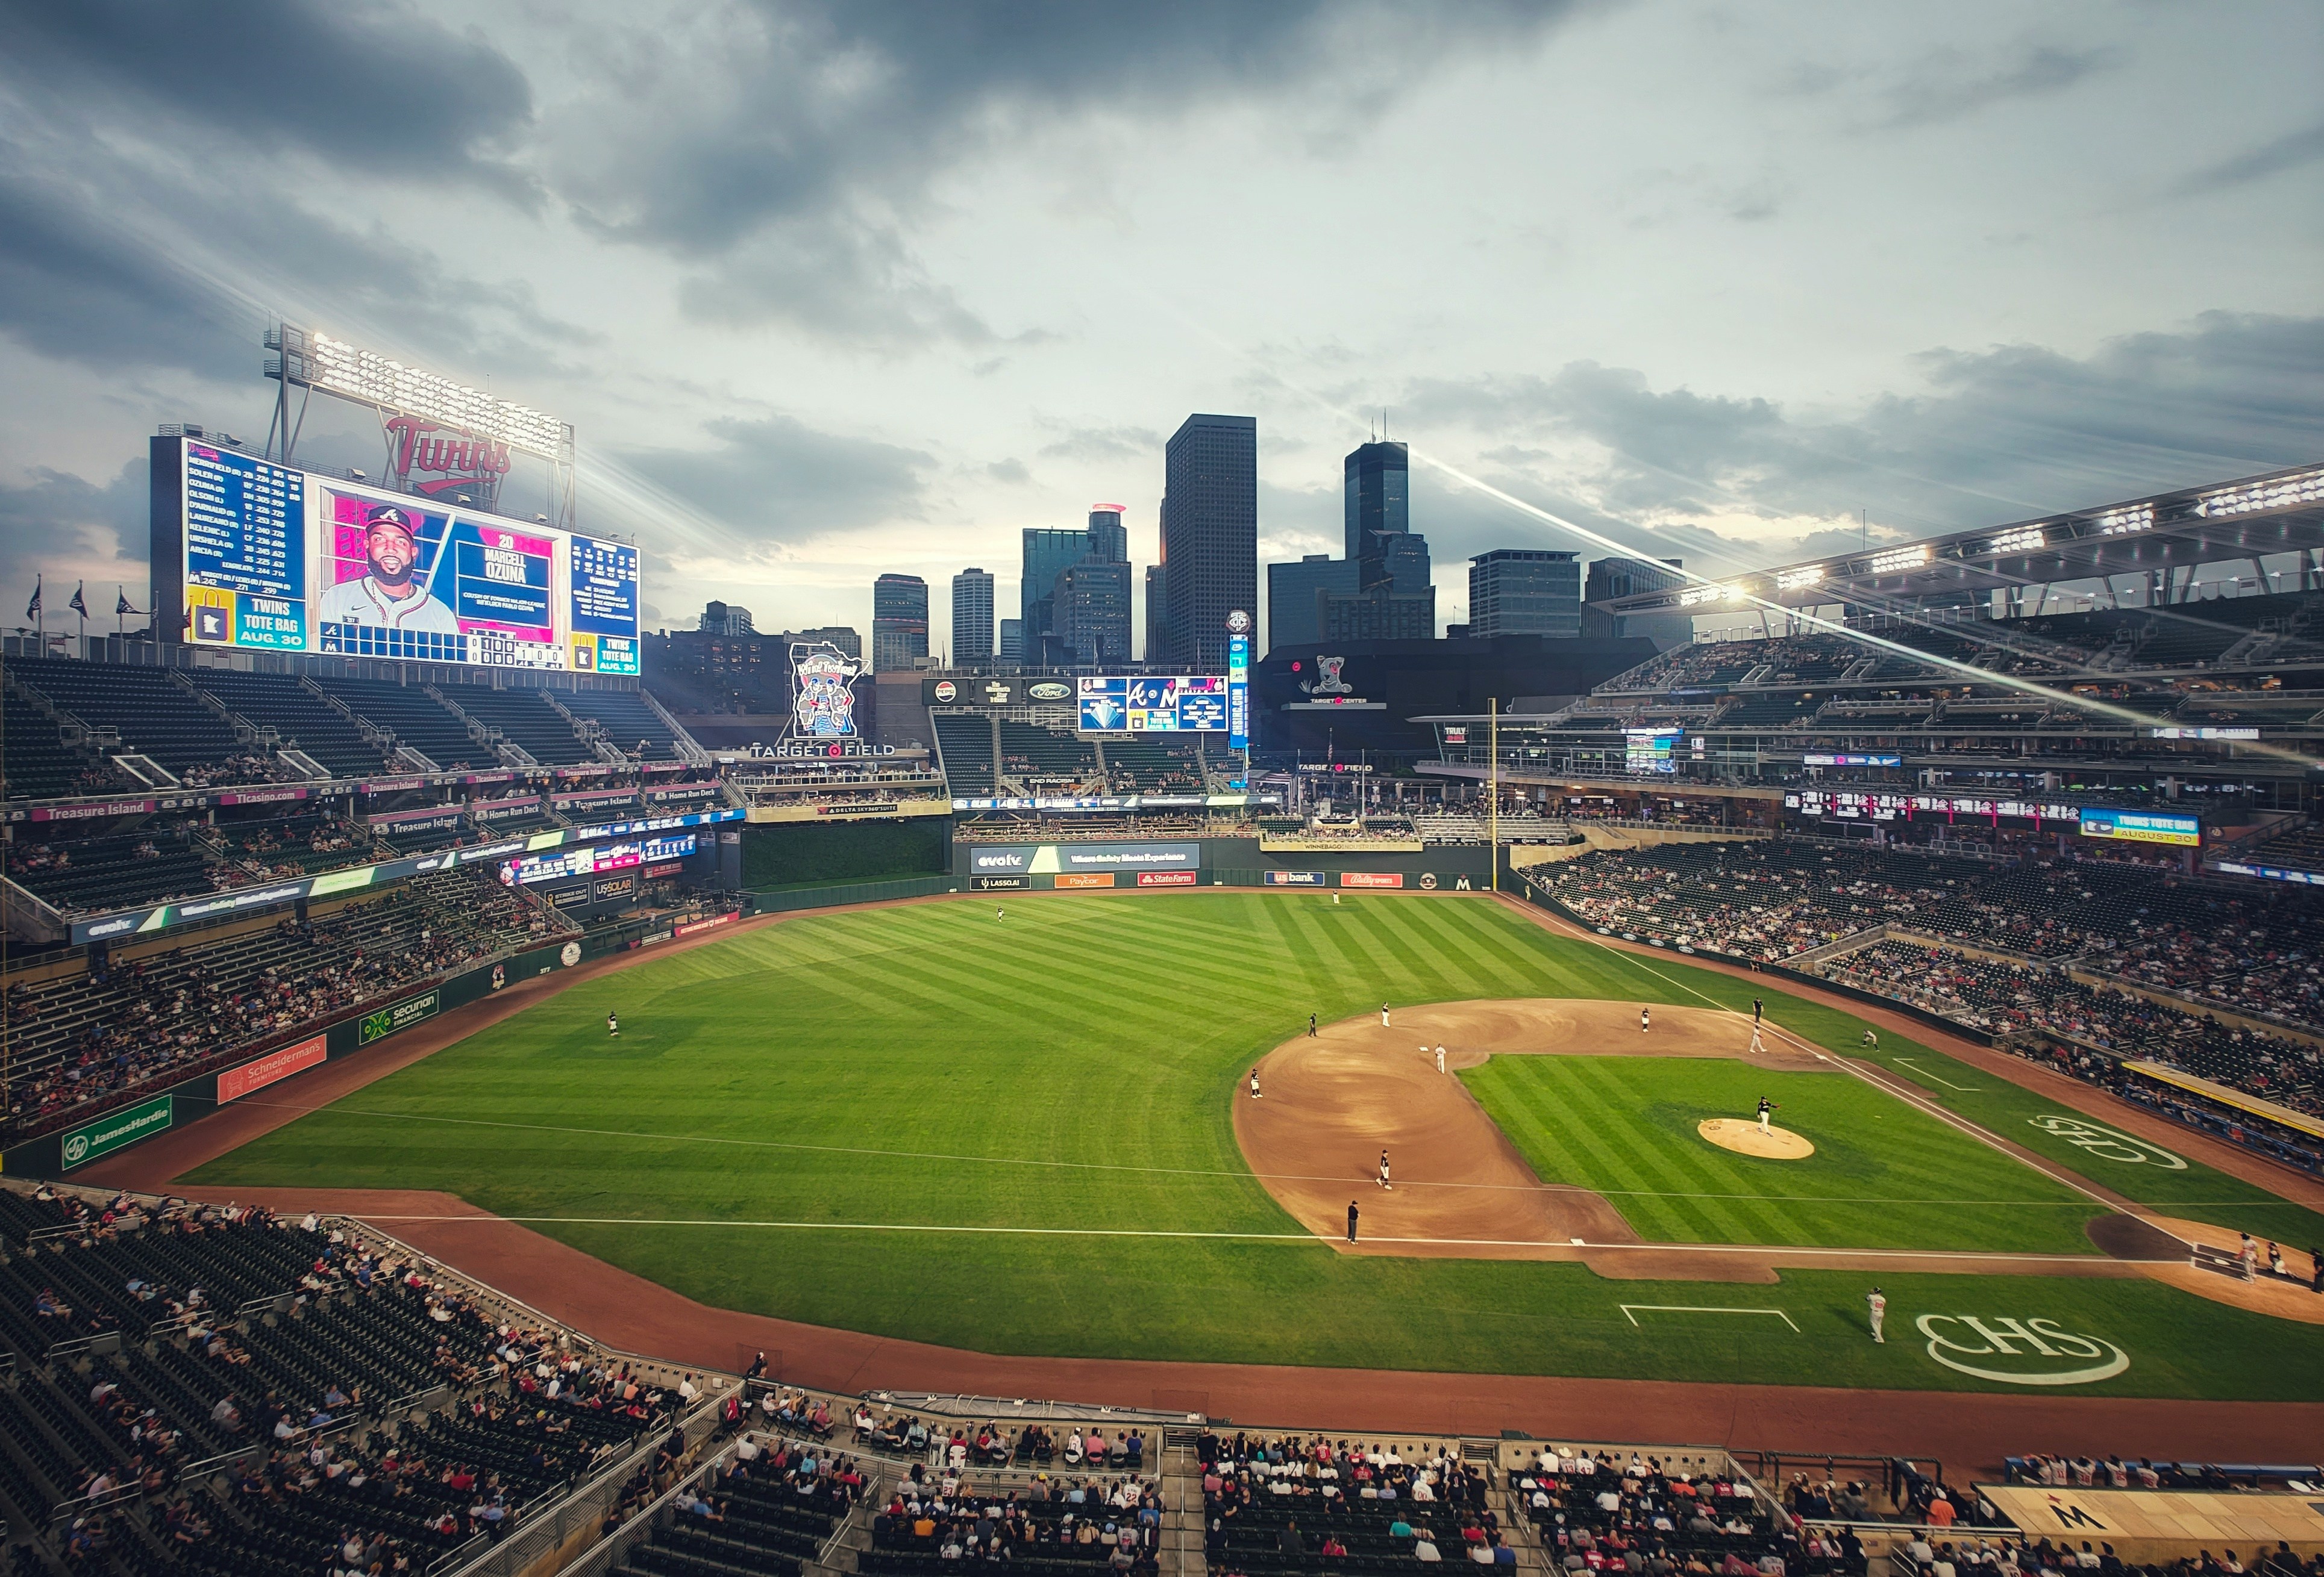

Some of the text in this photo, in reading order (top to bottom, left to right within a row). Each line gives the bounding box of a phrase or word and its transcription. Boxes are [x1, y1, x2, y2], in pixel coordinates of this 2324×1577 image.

[386, 416, 512, 475] Twins
[189, 467, 213, 479] SOLER
[189, 490, 215, 502] OLSON
[498, 534, 514, 549] 20
[485, 548, 527, 568] MARCELL
[486, 561, 527, 584] OZUNA
[251, 598, 290, 616] TWINS
[243, 614, 298, 633] TOTE BAG
[240, 631, 302, 646] AUG. 30
[606, 639, 630, 651] TWINS
[601, 650, 619, 661] TOTE
[1036, 687, 1062, 698] Ford
[750, 745, 897, 758] TARGET FIELD
[368, 781, 419, 793] Treasure Island
[669, 791, 687, 799] Home
[701, 788, 715, 796] Deck
[610, 796, 632, 805] Island
[47, 802, 144, 820] Treasure Island
[489, 804, 540, 820] Home Run Deck
[393, 821, 433, 834] Treasure
[2149, 818, 2174, 829] TOTE
[2174, 820, 2196, 831] BAG
[2120, 830, 2171, 841] AUGUST
[1145, 853, 1186, 862] Experience
[1070, 877, 1098, 887] Paycor
[1350, 873, 1375, 886] Bally
[555, 891, 575, 899] STRIKE
[539, 966, 551, 975] 377
[393, 995, 434, 1020] securian
[393, 1011, 424, 1026] FINANCIAL
[248, 1042, 321, 1079] Schneiderman's
[249, 1067, 283, 1085] FURNITURE
[91, 1109, 168, 1146] JamesHardie
[943, 1486, 953, 1496] 23
[1126, 1492, 1137, 1502] 22
